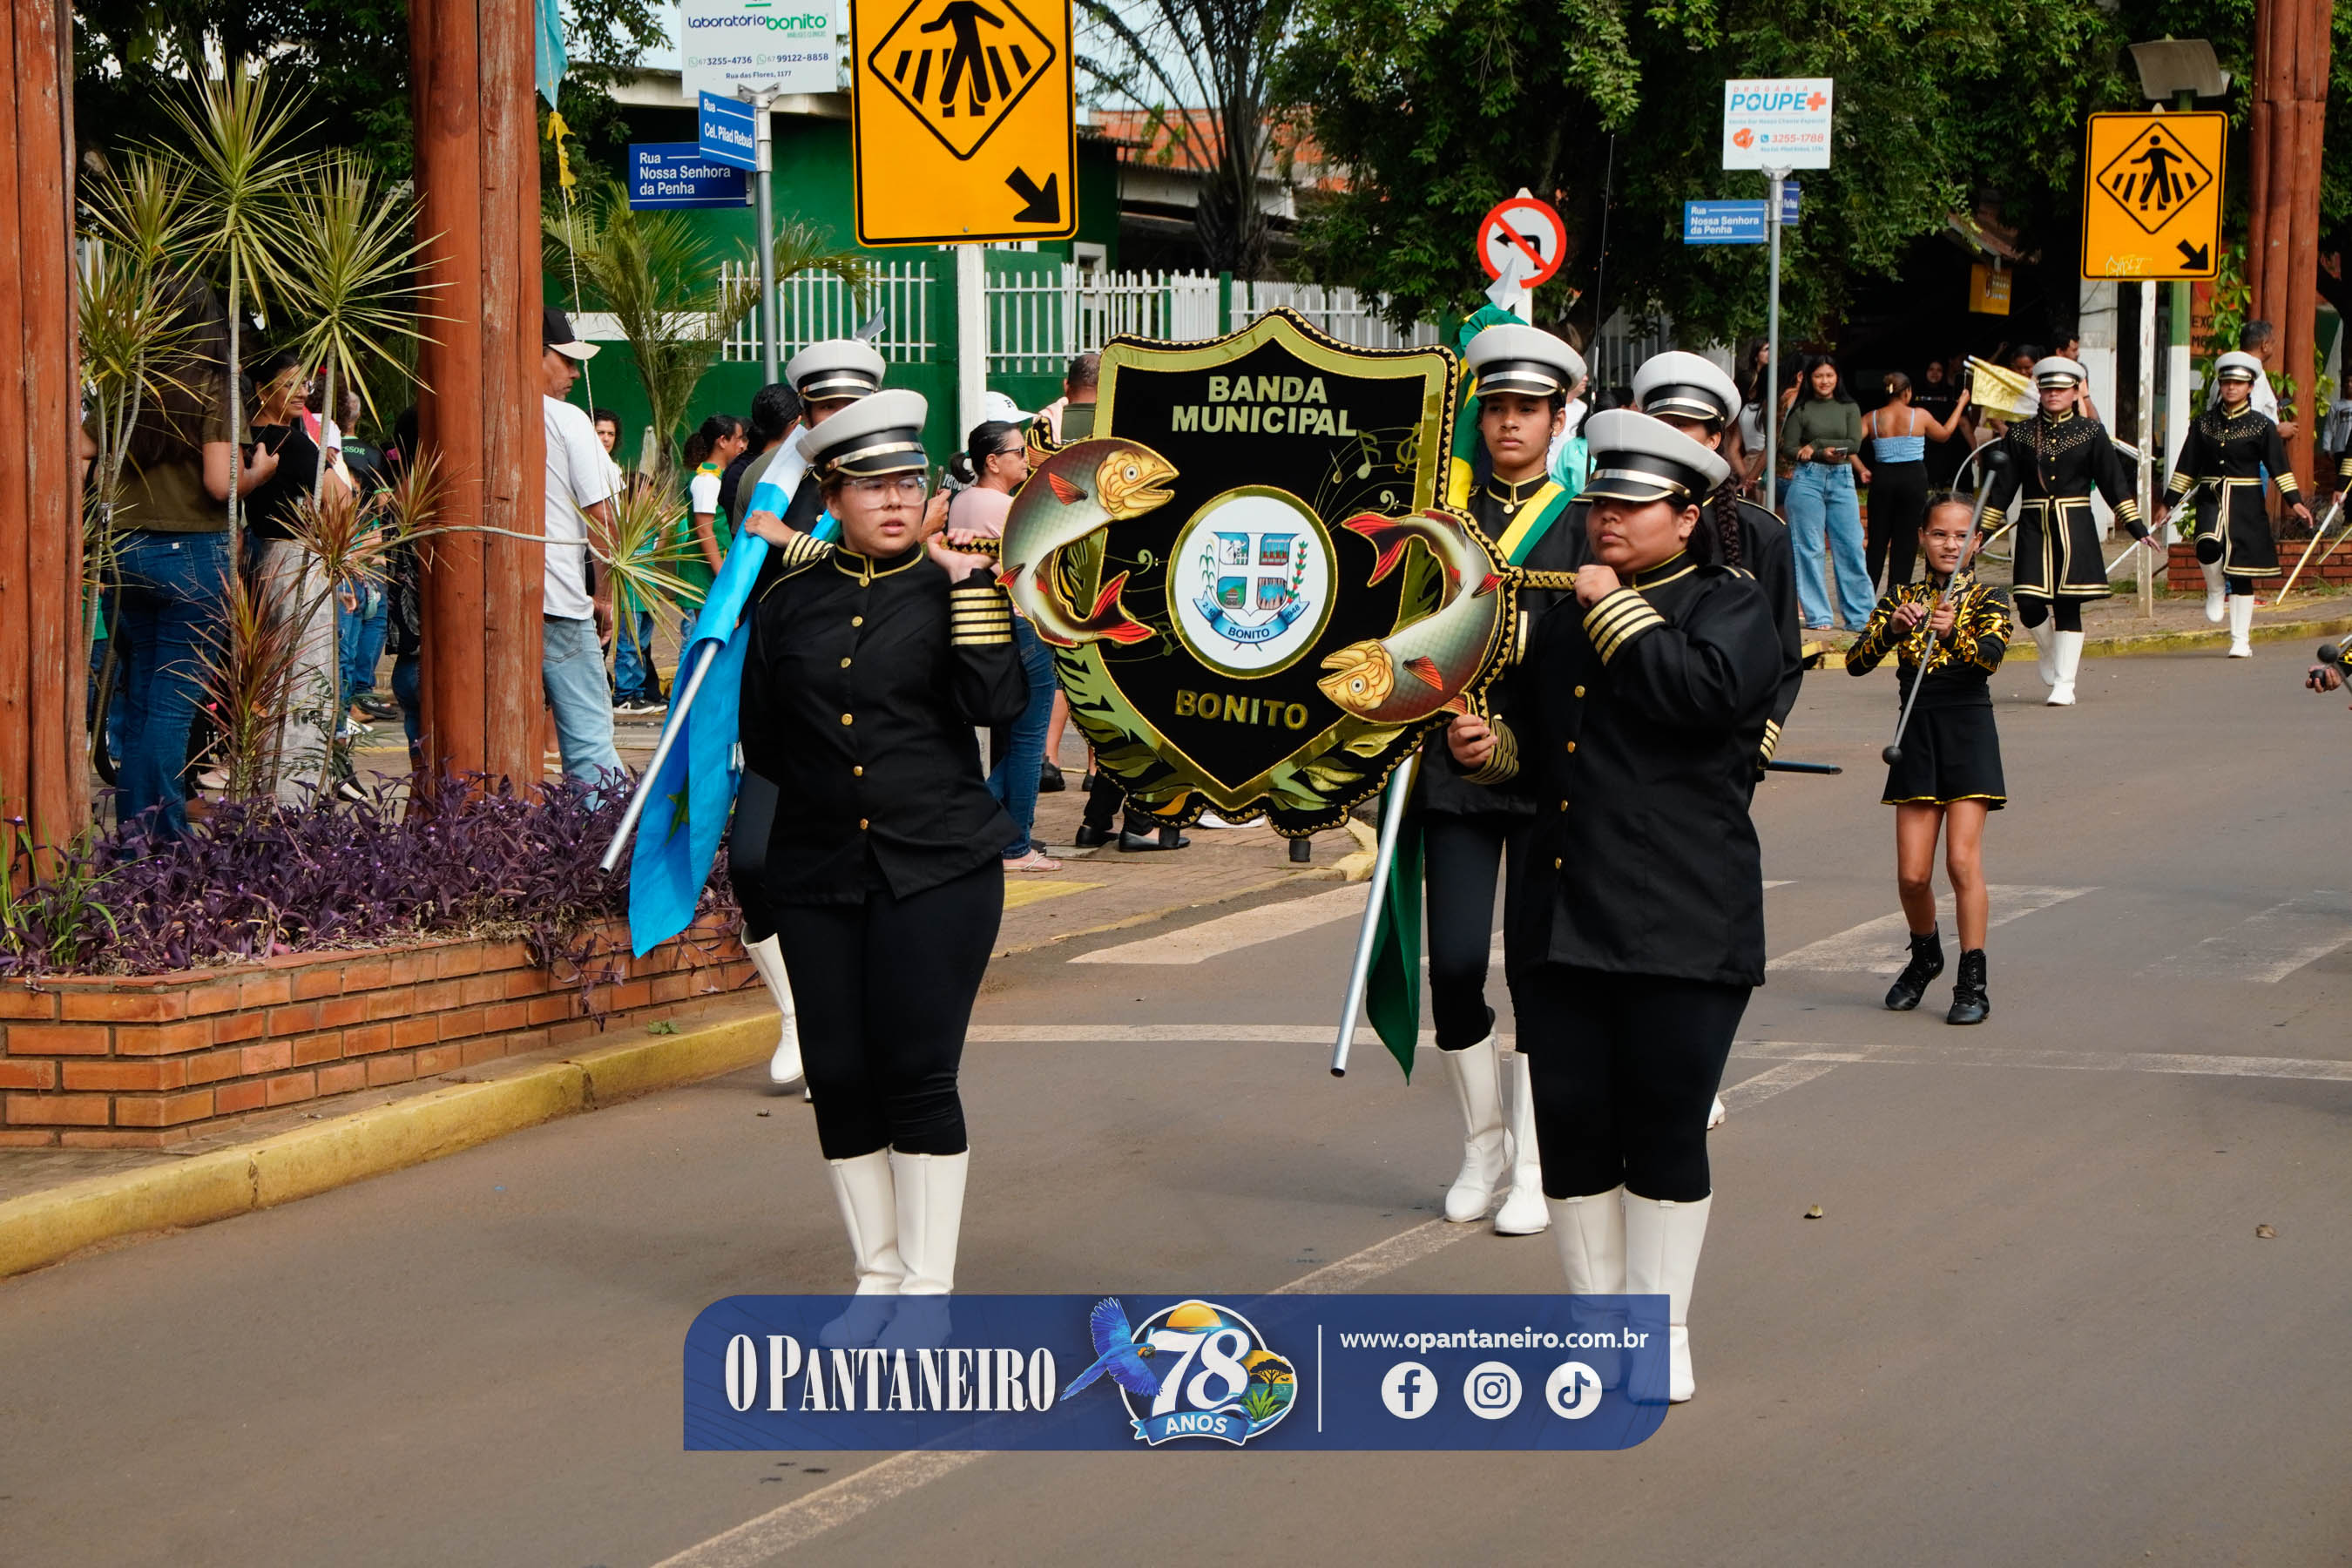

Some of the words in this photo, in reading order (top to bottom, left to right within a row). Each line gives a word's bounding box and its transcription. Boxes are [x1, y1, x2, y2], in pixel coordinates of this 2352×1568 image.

[704, 98, 716, 112] Rua
[704, 122, 718, 138] Cel.
[718, 125, 733, 143] Pilad
[733, 130, 754, 149] Rebuá
[639, 152, 661, 164] Rua
[639, 166, 677, 179] Nossa
[679, 165, 731, 179] Senhora
[639, 182, 655, 196] da
[658, 181, 695, 195] Penha
[1691, 217, 1719, 226] Nossa
[1721, 216, 1759, 225] Senhora
[1704, 226, 1733, 234] Penha
[1208, 375, 1328, 404] BANDA
[1172, 405, 1358, 436] MUNICIPAL
[1227, 626, 1270, 639] BONITO
[1175, 689, 1308, 730] BONITO
